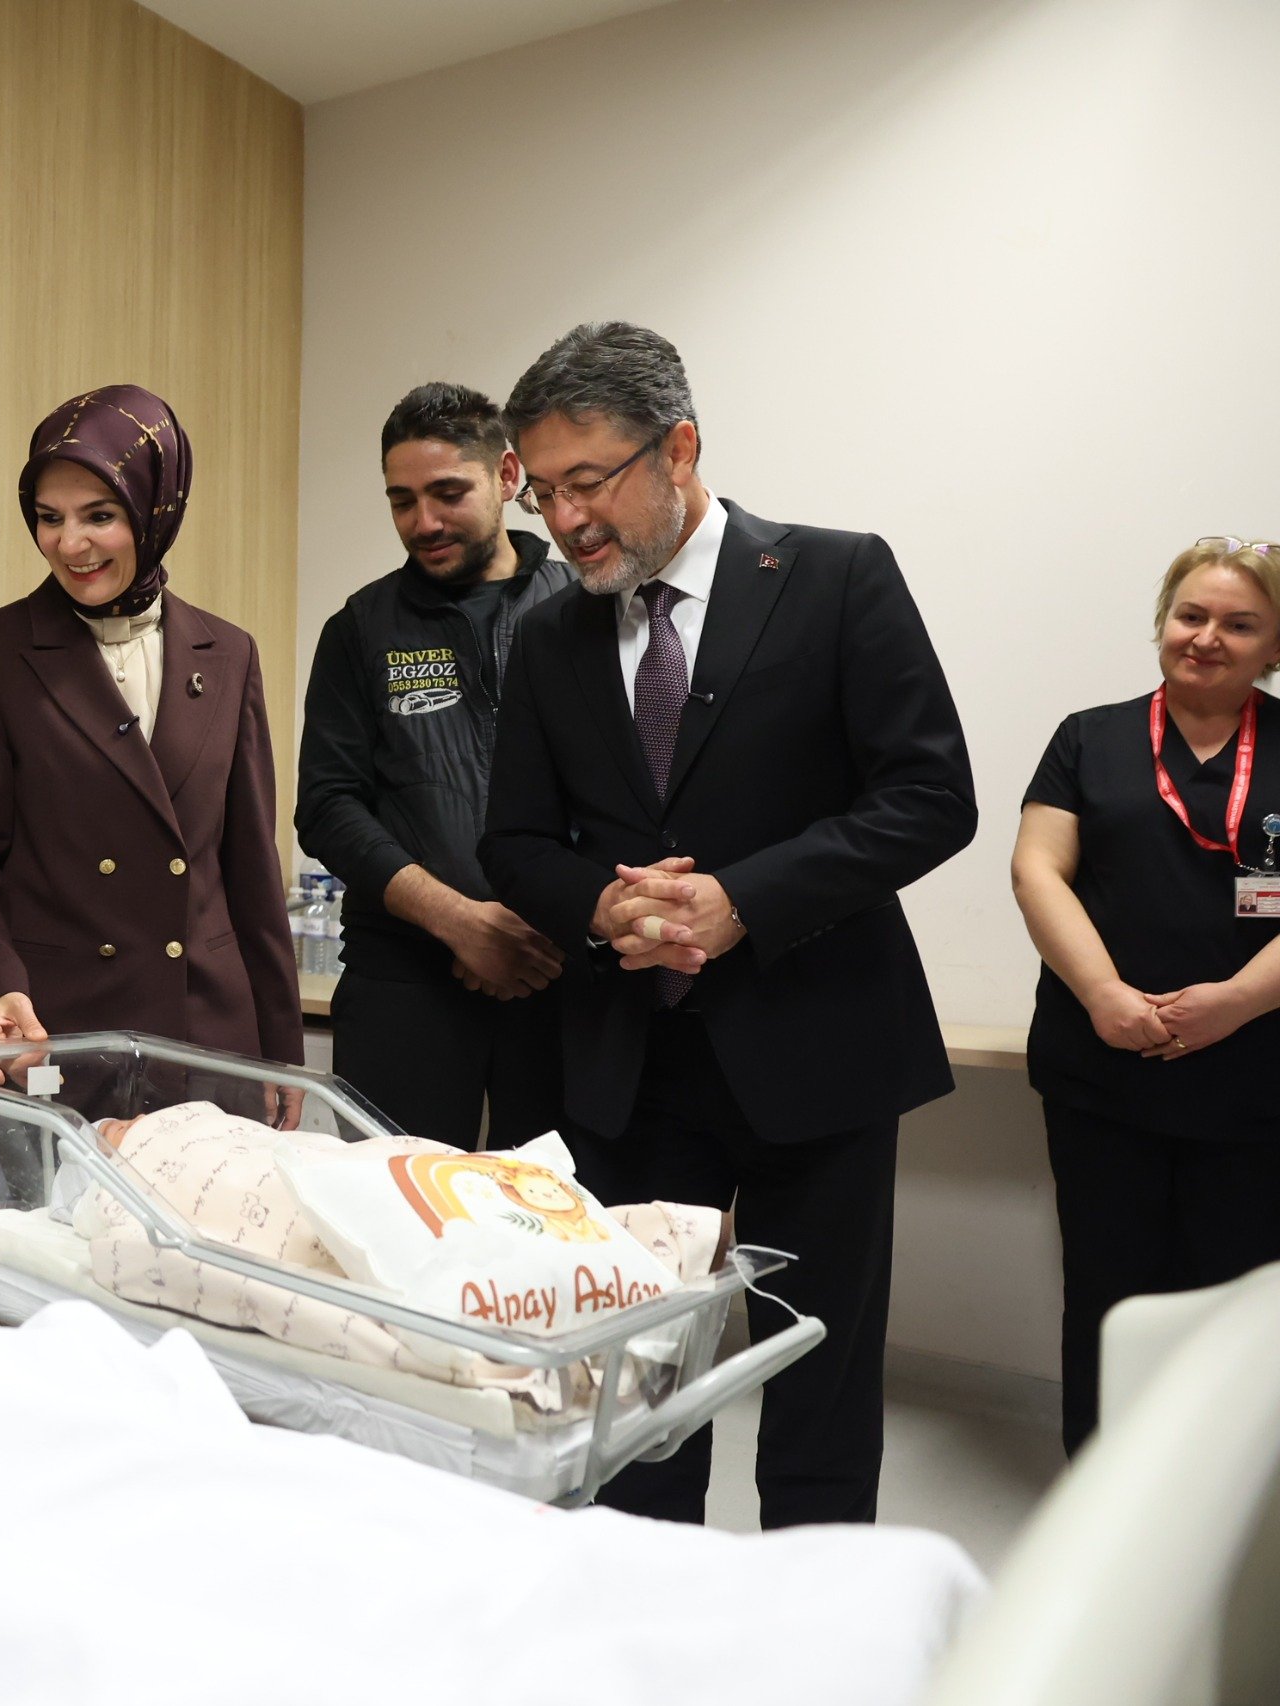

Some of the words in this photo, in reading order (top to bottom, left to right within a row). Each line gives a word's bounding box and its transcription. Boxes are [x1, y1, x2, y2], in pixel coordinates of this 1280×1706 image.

[386, 648, 455, 665] ÜNVER
[388, 663, 456, 681] EGZOZ
[388, 680, 411, 692] 0553
[413, 678, 431, 689] 230
[432, 678, 445, 687] 75
[447, 677, 459, 687] 74
[461, 1279, 557, 1329] Alpay
